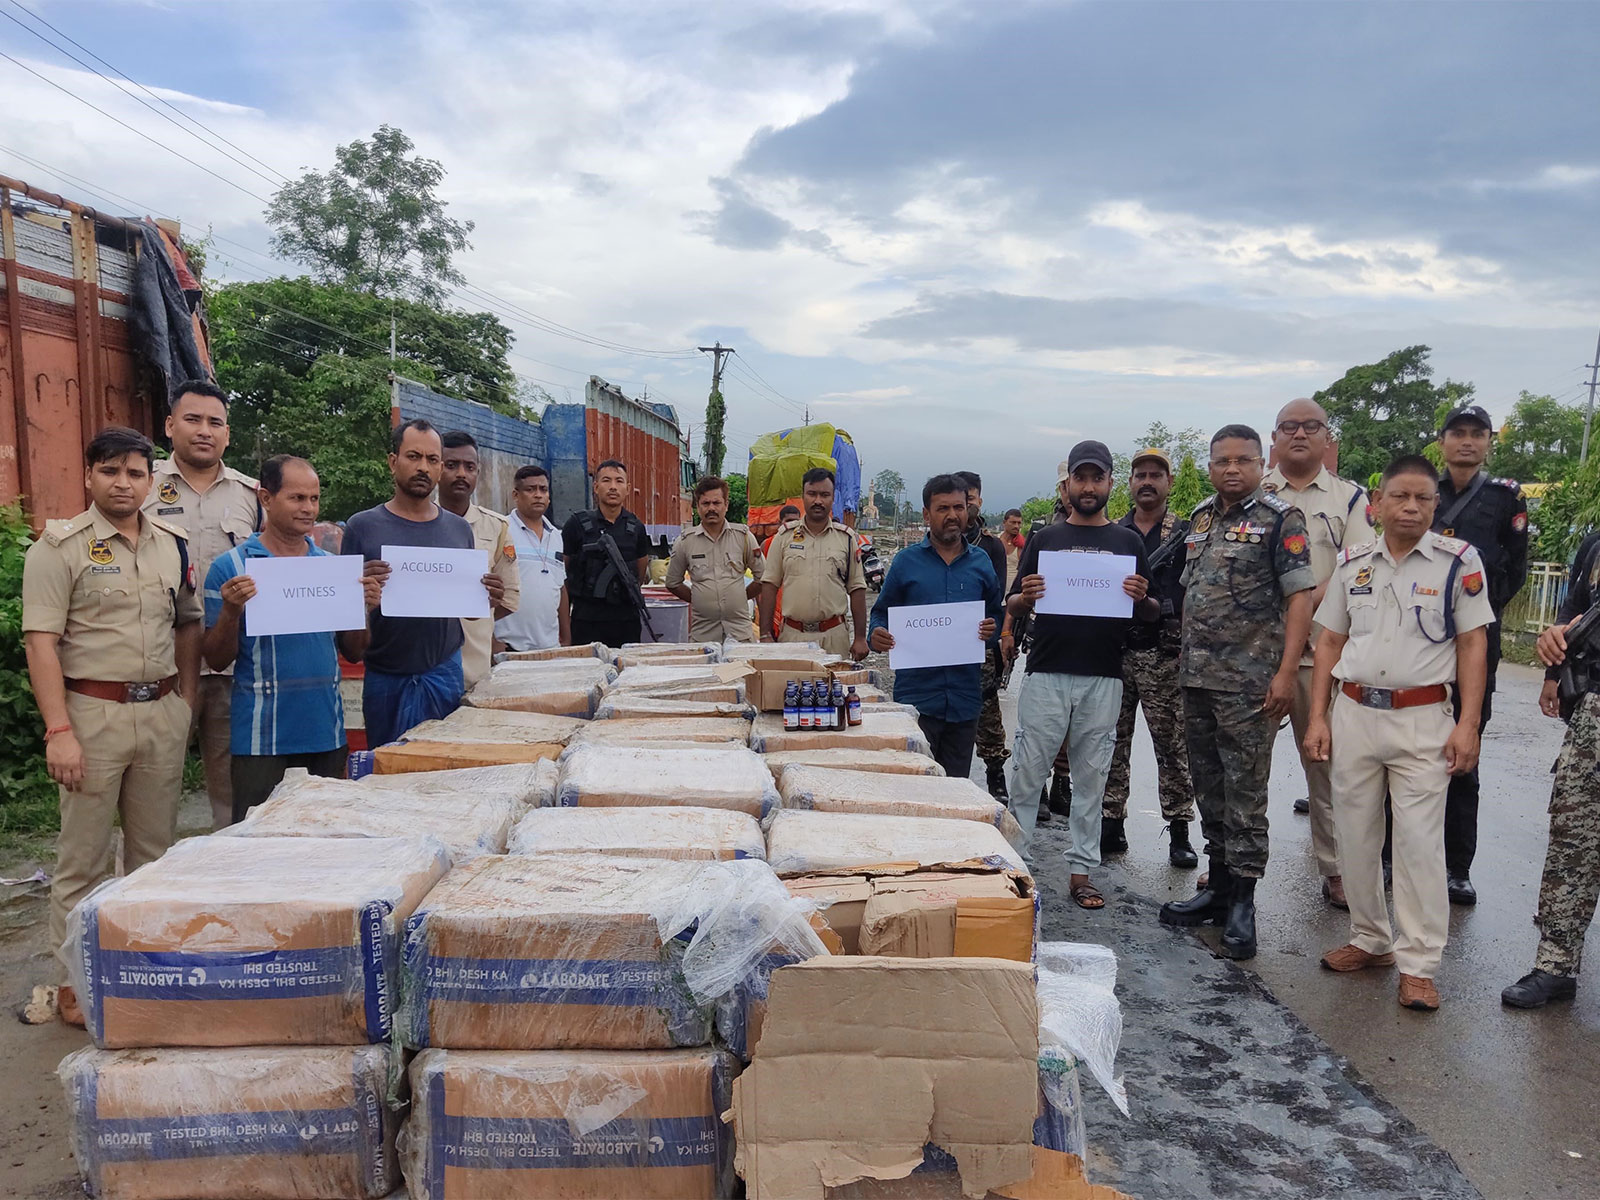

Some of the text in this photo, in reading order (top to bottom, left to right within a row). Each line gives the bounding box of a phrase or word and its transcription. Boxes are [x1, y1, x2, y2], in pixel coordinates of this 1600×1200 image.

[400, 561, 453, 573] ACCUSED
[1066, 577, 1111, 589] WITNESS
[282, 585, 336, 599] WITNESS
[905, 616, 952, 628] ACCUSED
[371, 922, 383, 965] TESTED
[243, 961, 318, 974] TRUSTED BHI
[435, 967, 456, 980] BHI,
[459, 968, 488, 980] DESH
[491, 970, 508, 980] KA
[119, 971, 183, 987] LABORATE
[219, 973, 343, 989] TESTED BHI, DESH KA
[543, 971, 610, 988] LABORATE
[621, 971, 661, 982] TESTED
[163, 1123, 288, 1139] TESTED BHI, DESH KA
[464, 1131, 537, 1144] TRUSTED BHI
[459, 1146, 489, 1157] DESH
[493, 1146, 515, 1158] BHI,
[518, 1146, 561, 1158] TESTED
[572, 1142, 640, 1155] LABORATE
[676, 1145, 693, 1156] KA
